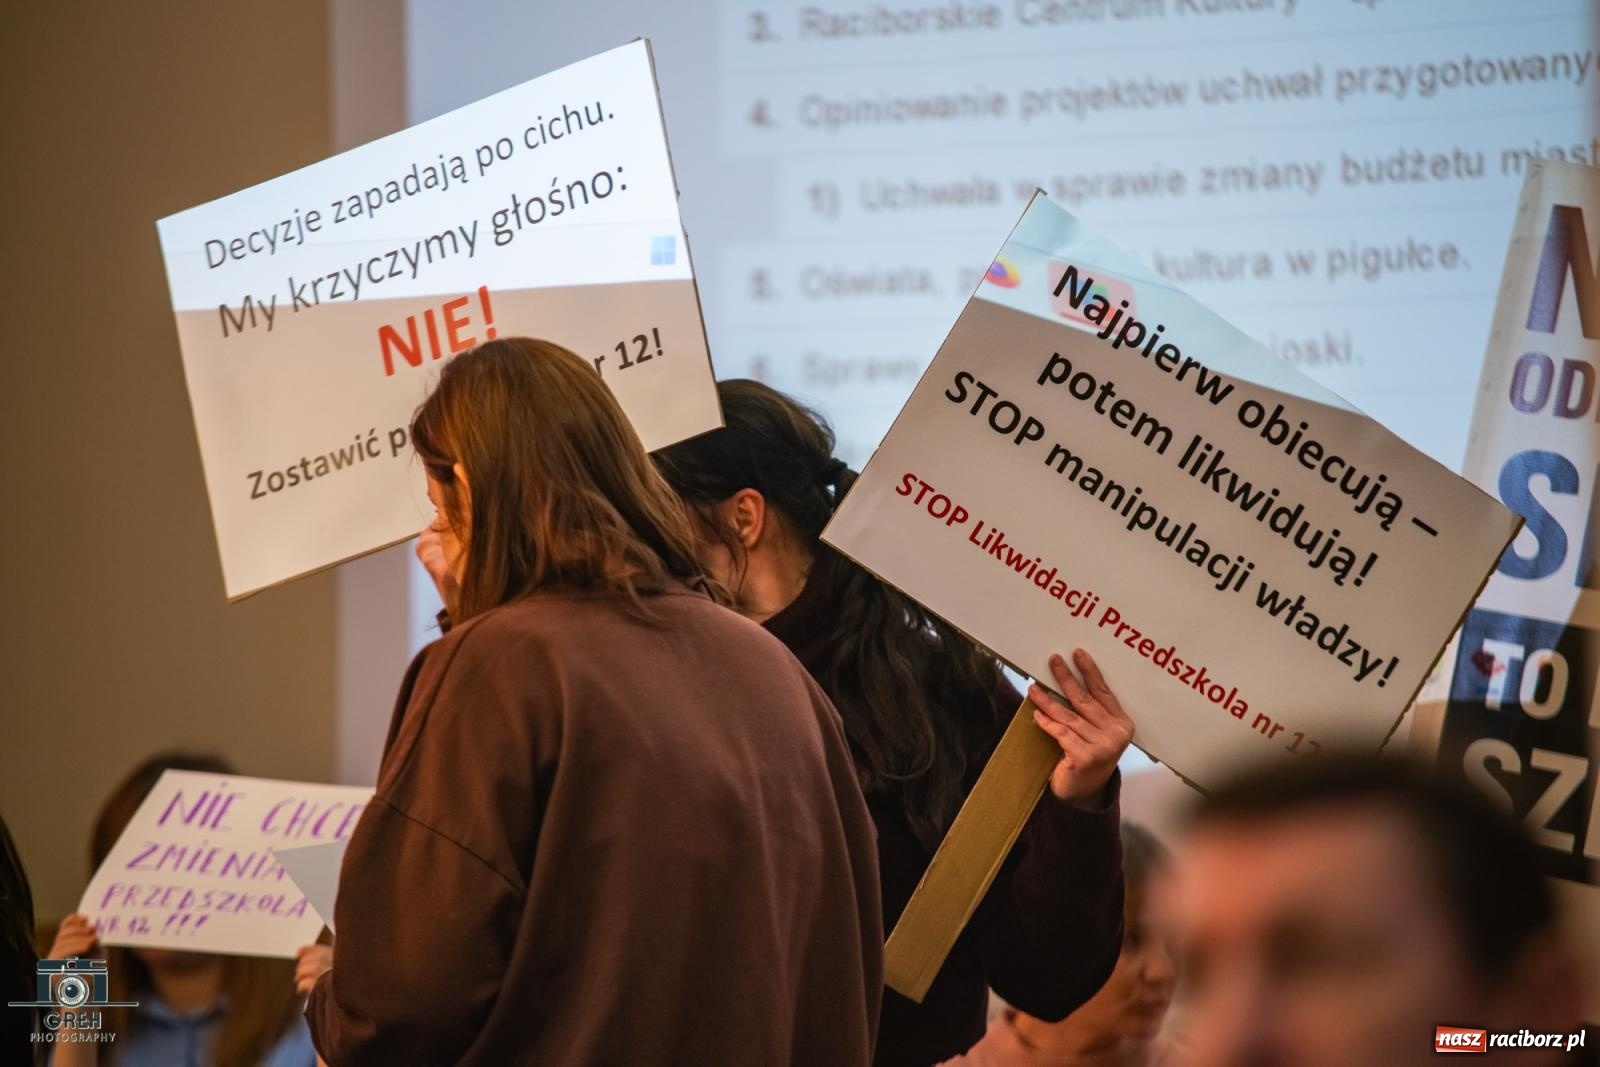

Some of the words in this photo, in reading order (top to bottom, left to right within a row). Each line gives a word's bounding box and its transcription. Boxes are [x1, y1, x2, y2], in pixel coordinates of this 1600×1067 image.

[799, 83, 1006, 132] Opiniowanie
[1018, 73, 1190, 121] projektów
[1199, 62, 1324, 105] uchwał
[205, 207, 322, 270] Decyzje
[331, 153, 469, 225] zapadają
[475, 136, 515, 177] po
[523, 99, 616, 151] cichu.
[1052, 163, 1189, 205] sprawie
[1199, 156, 1326, 195] zmiany
[1340, 146, 1485, 188] budżetu
[218, 293, 278, 340] My
[288, 220, 478, 316] krzyczymy
[491, 164, 629, 249] głośno:
[1152, 245, 1274, 284] kultura
[1286, 248, 1317, 277] w
[1326, 235, 1472, 284] pigułce.
[377, 285, 498, 377] NIE!
[247, 426, 381, 501] Zostawić
[614, 327, 664, 370] 12!
[1052, 263, 1236, 406] Najpierw
[1238, 397, 1404, 530] obiecują
[1508, 351, 1600, 425] OD
[1037, 351, 1174, 455] potem
[1177, 434, 1380, 588] likwidują!
[945, 371, 1045, 448] STOP
[1045, 439, 1257, 597] manipulacji
[1255, 579, 1400, 688] władzy!
[895, 472, 969, 529] STOP
[969, 519, 1100, 620] Likwidacji
[1098, 606, 1249, 722] Przedszkola
[1251, 712, 1285, 739] nr
[1481, 638, 1570, 721] TO
[157, 780, 246, 833] NIE
[1462, 737, 1600, 862] SZ
[99, 882, 311, 919] PRZEDSZKOLA
